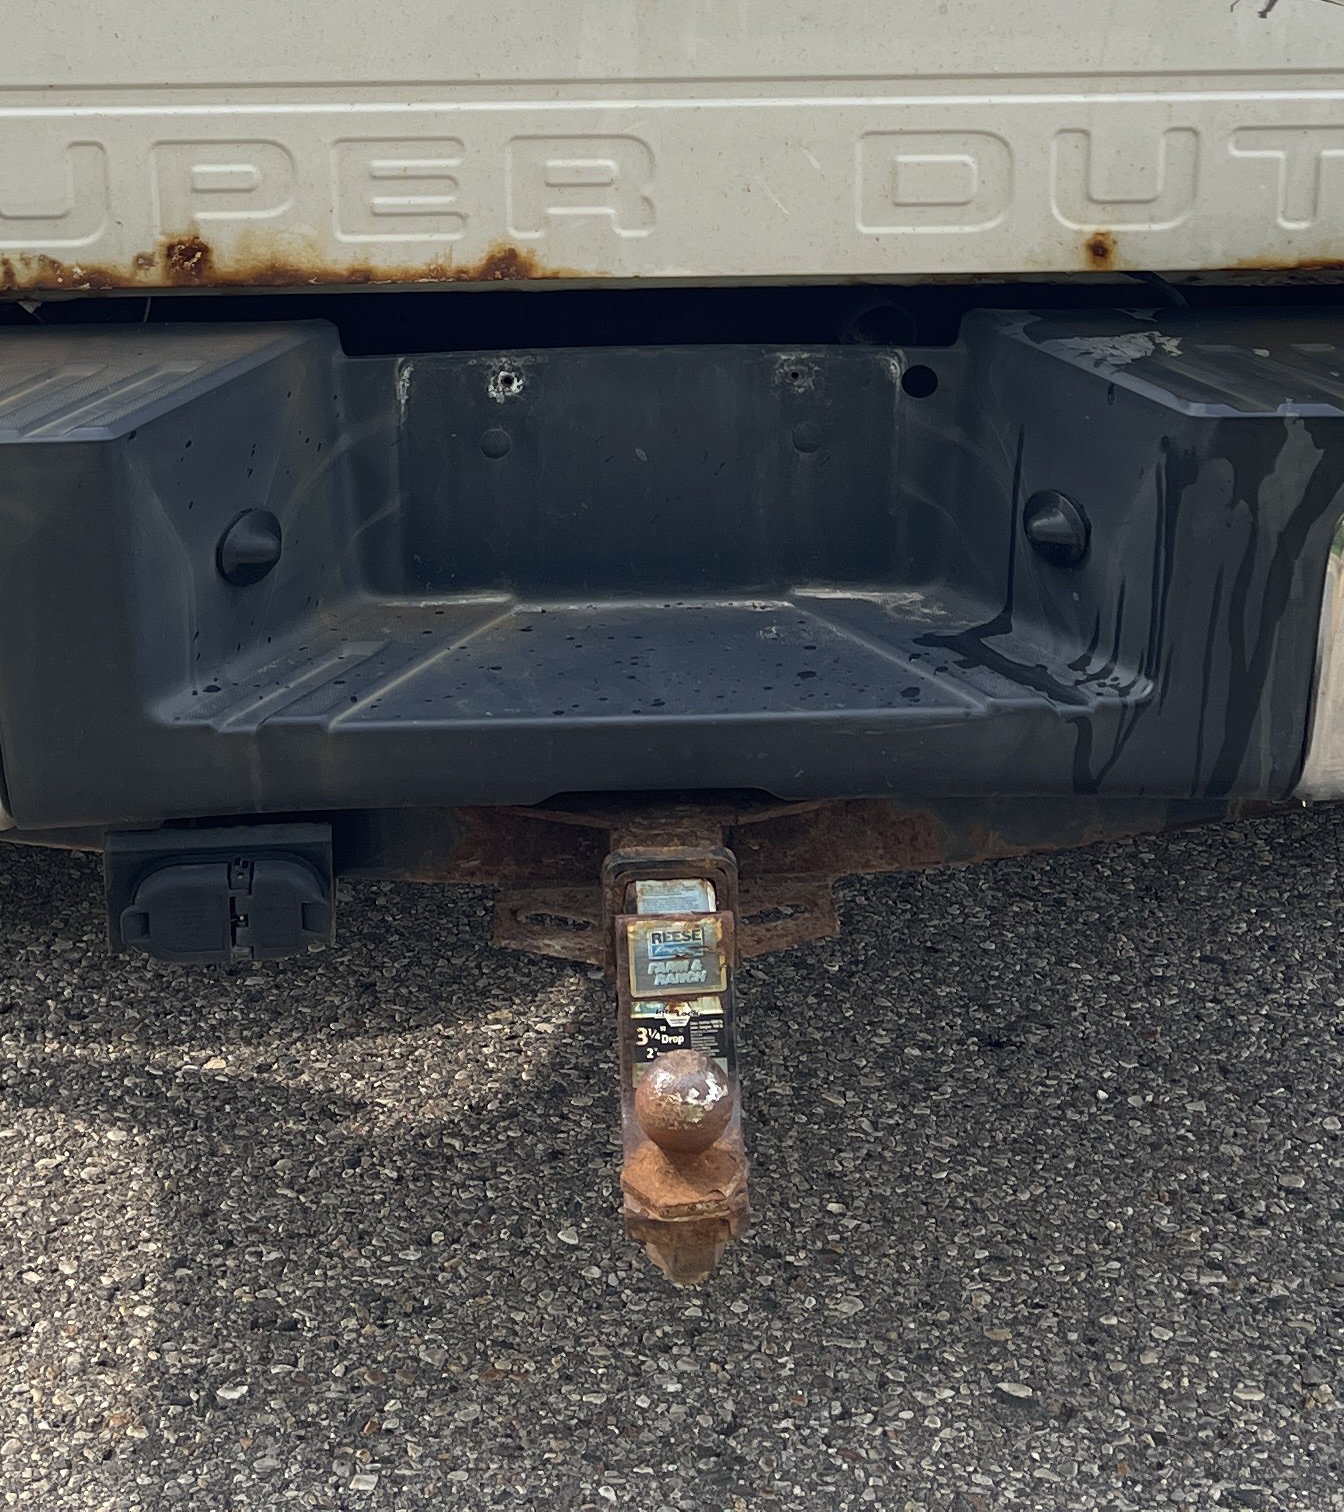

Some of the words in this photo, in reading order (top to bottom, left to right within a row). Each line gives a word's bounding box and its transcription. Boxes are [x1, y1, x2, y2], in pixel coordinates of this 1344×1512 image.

[651, 929, 702, 945] REESE
[654, 969, 707, 986] RANCH
[661, 1034, 685, 1046] Drop
